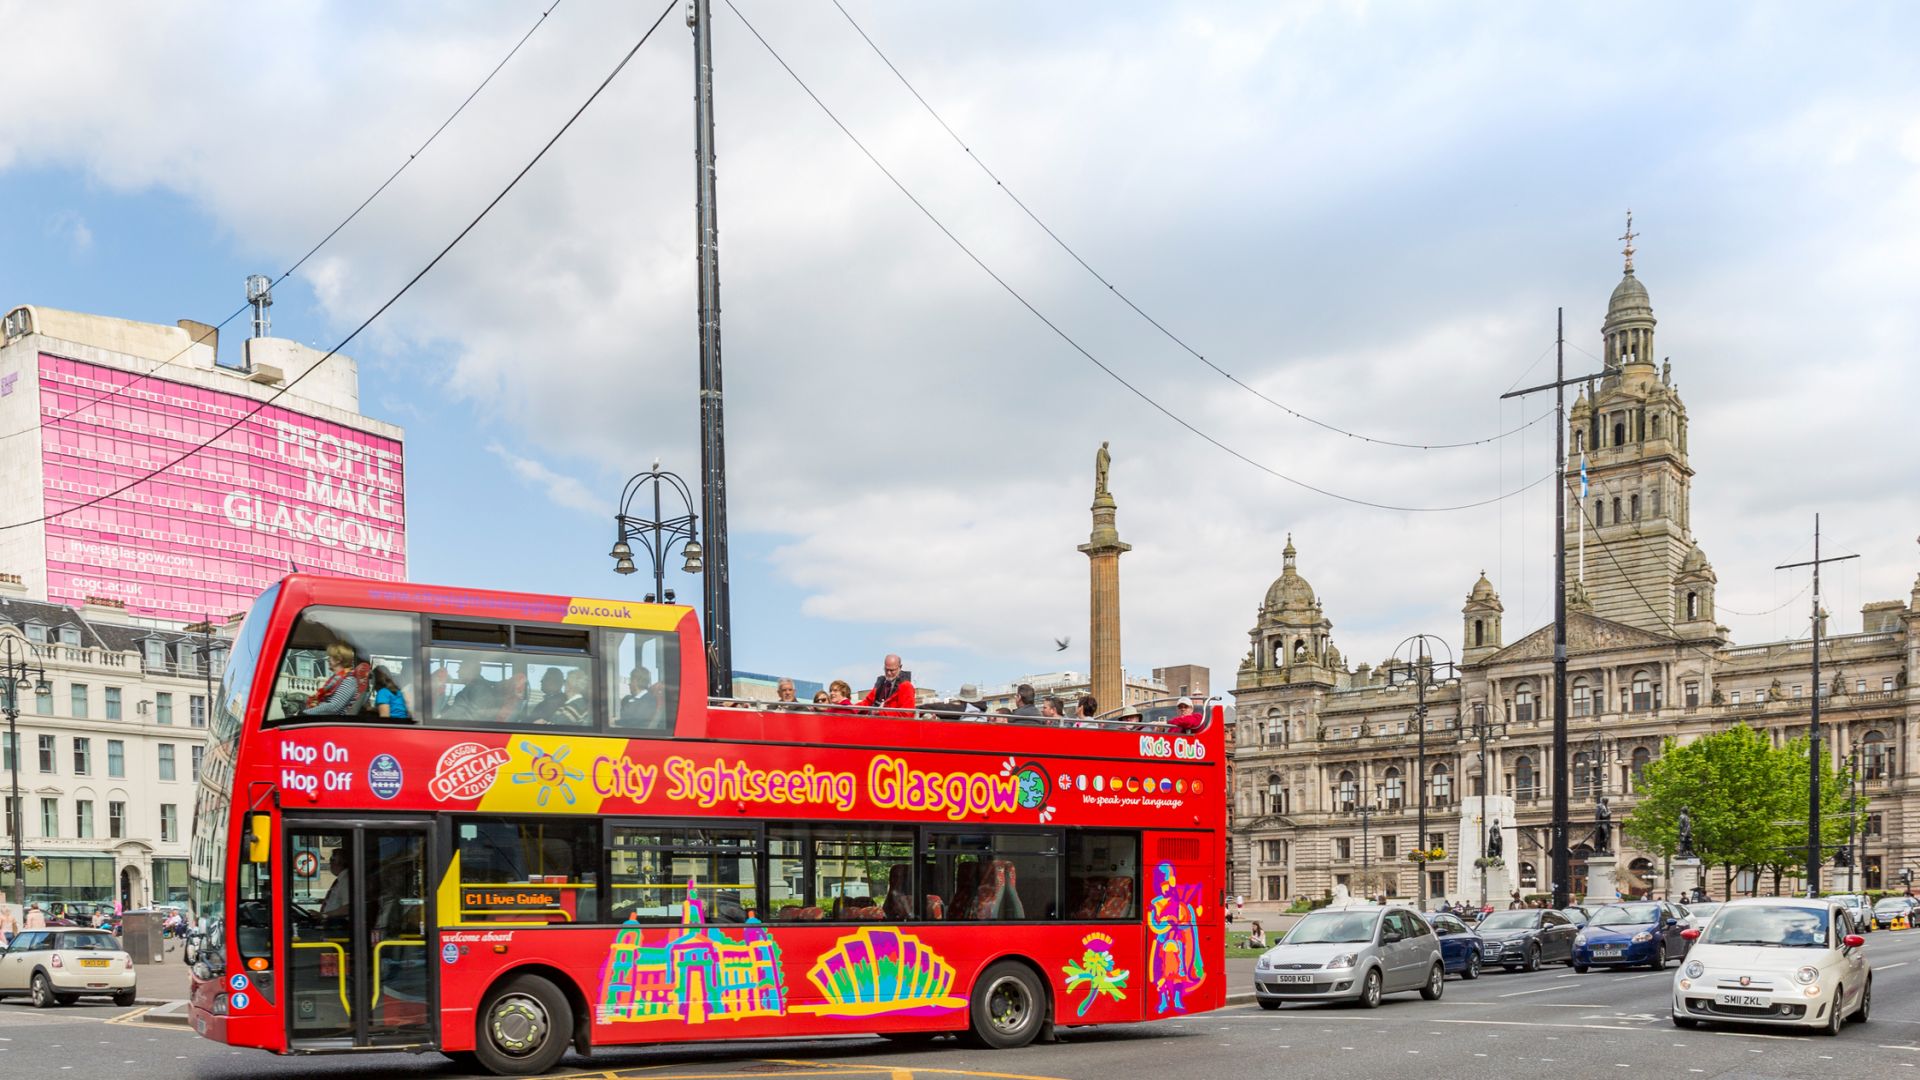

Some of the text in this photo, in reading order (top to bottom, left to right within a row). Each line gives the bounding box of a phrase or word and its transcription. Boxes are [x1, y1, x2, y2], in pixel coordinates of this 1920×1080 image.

[277, 420, 394, 485] PEOPLE
[306, 470, 394, 521] MAKE
[224, 491, 394, 559] GLASGOW
[71, 539, 193, 567] investglasgow.com
[72, 576, 142, 596] cogc.ac.uk
[281, 741, 348, 764] Hop On
[444, 745, 478, 767] GLASGOW
[1140, 735, 1205, 759] Kids Club
[281, 770, 352, 793] Hop Off
[437, 751, 507, 793] OFFICIAL
[464, 773, 494, 795] TOUR
[592, 753, 1021, 820] City Sightseeing Glasgow
[1082, 794, 1183, 809] We speak your language
[465, 893, 553, 905] C1 Live Guide
[441, 930, 514, 943] welcome aboard
[1743, 996, 1762, 1006] ZKL
